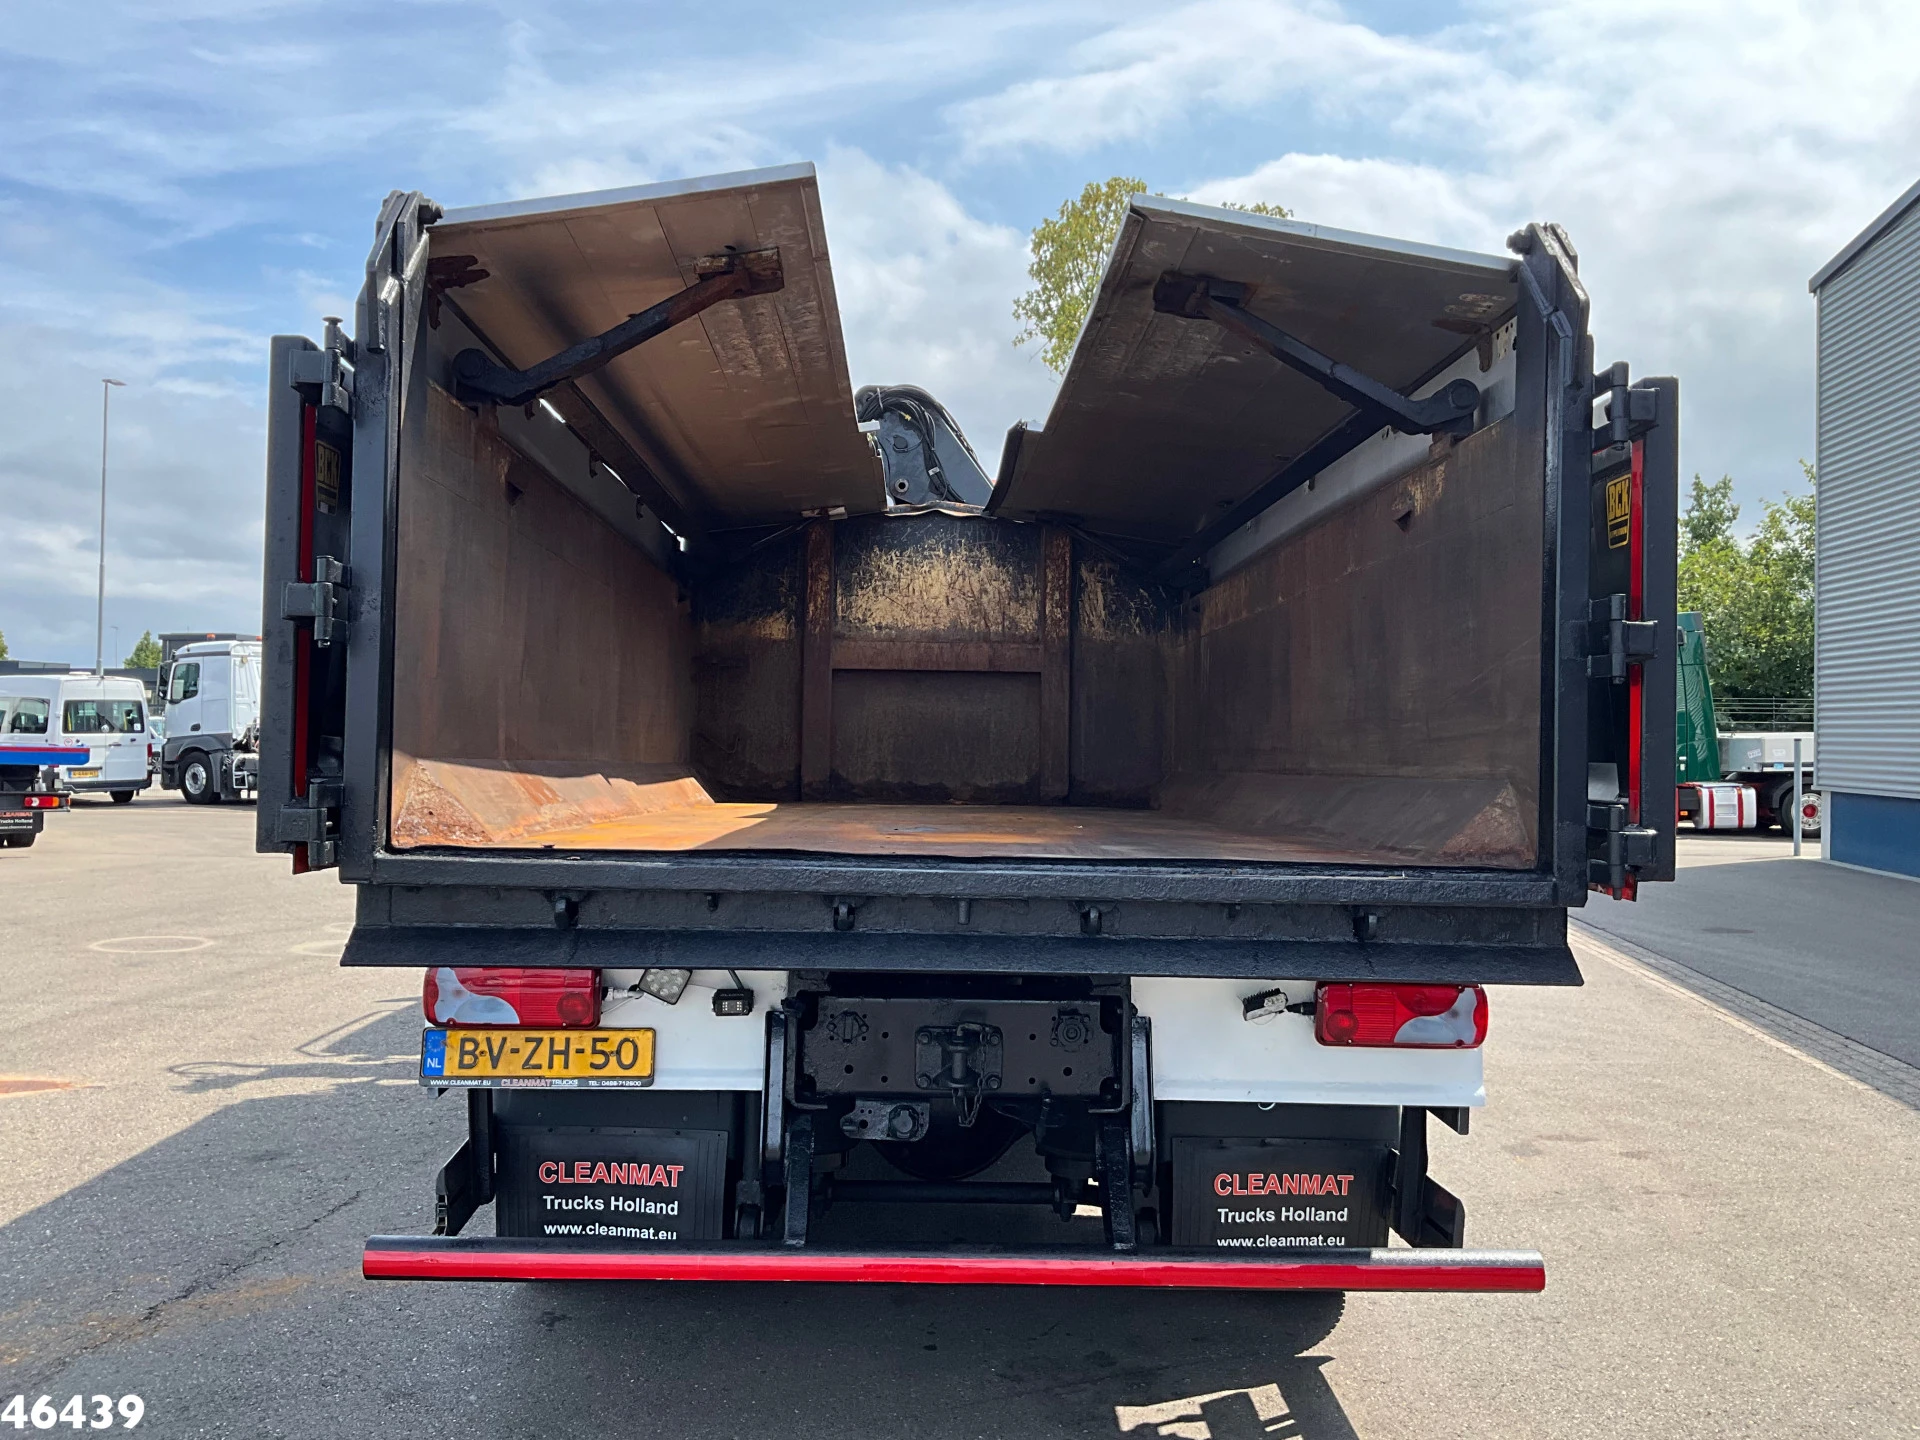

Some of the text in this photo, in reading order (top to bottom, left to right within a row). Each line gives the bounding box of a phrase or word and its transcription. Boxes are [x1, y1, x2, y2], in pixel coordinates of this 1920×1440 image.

[426, 1057, 442, 1068] NL
[457, 1036, 639, 1070] BV-ZH-50
[538, 1161, 684, 1188] CLEANMAT
[1213, 1173, 1355, 1196] CLEANMAT
[542, 1195, 679, 1215] Trucks Holland
[1217, 1207, 1348, 1223] Trucks Holland
[543, 1222, 677, 1240] www.cleanmat.eu
[1217, 1234, 1345, 1247] www.cleanmat.eu
